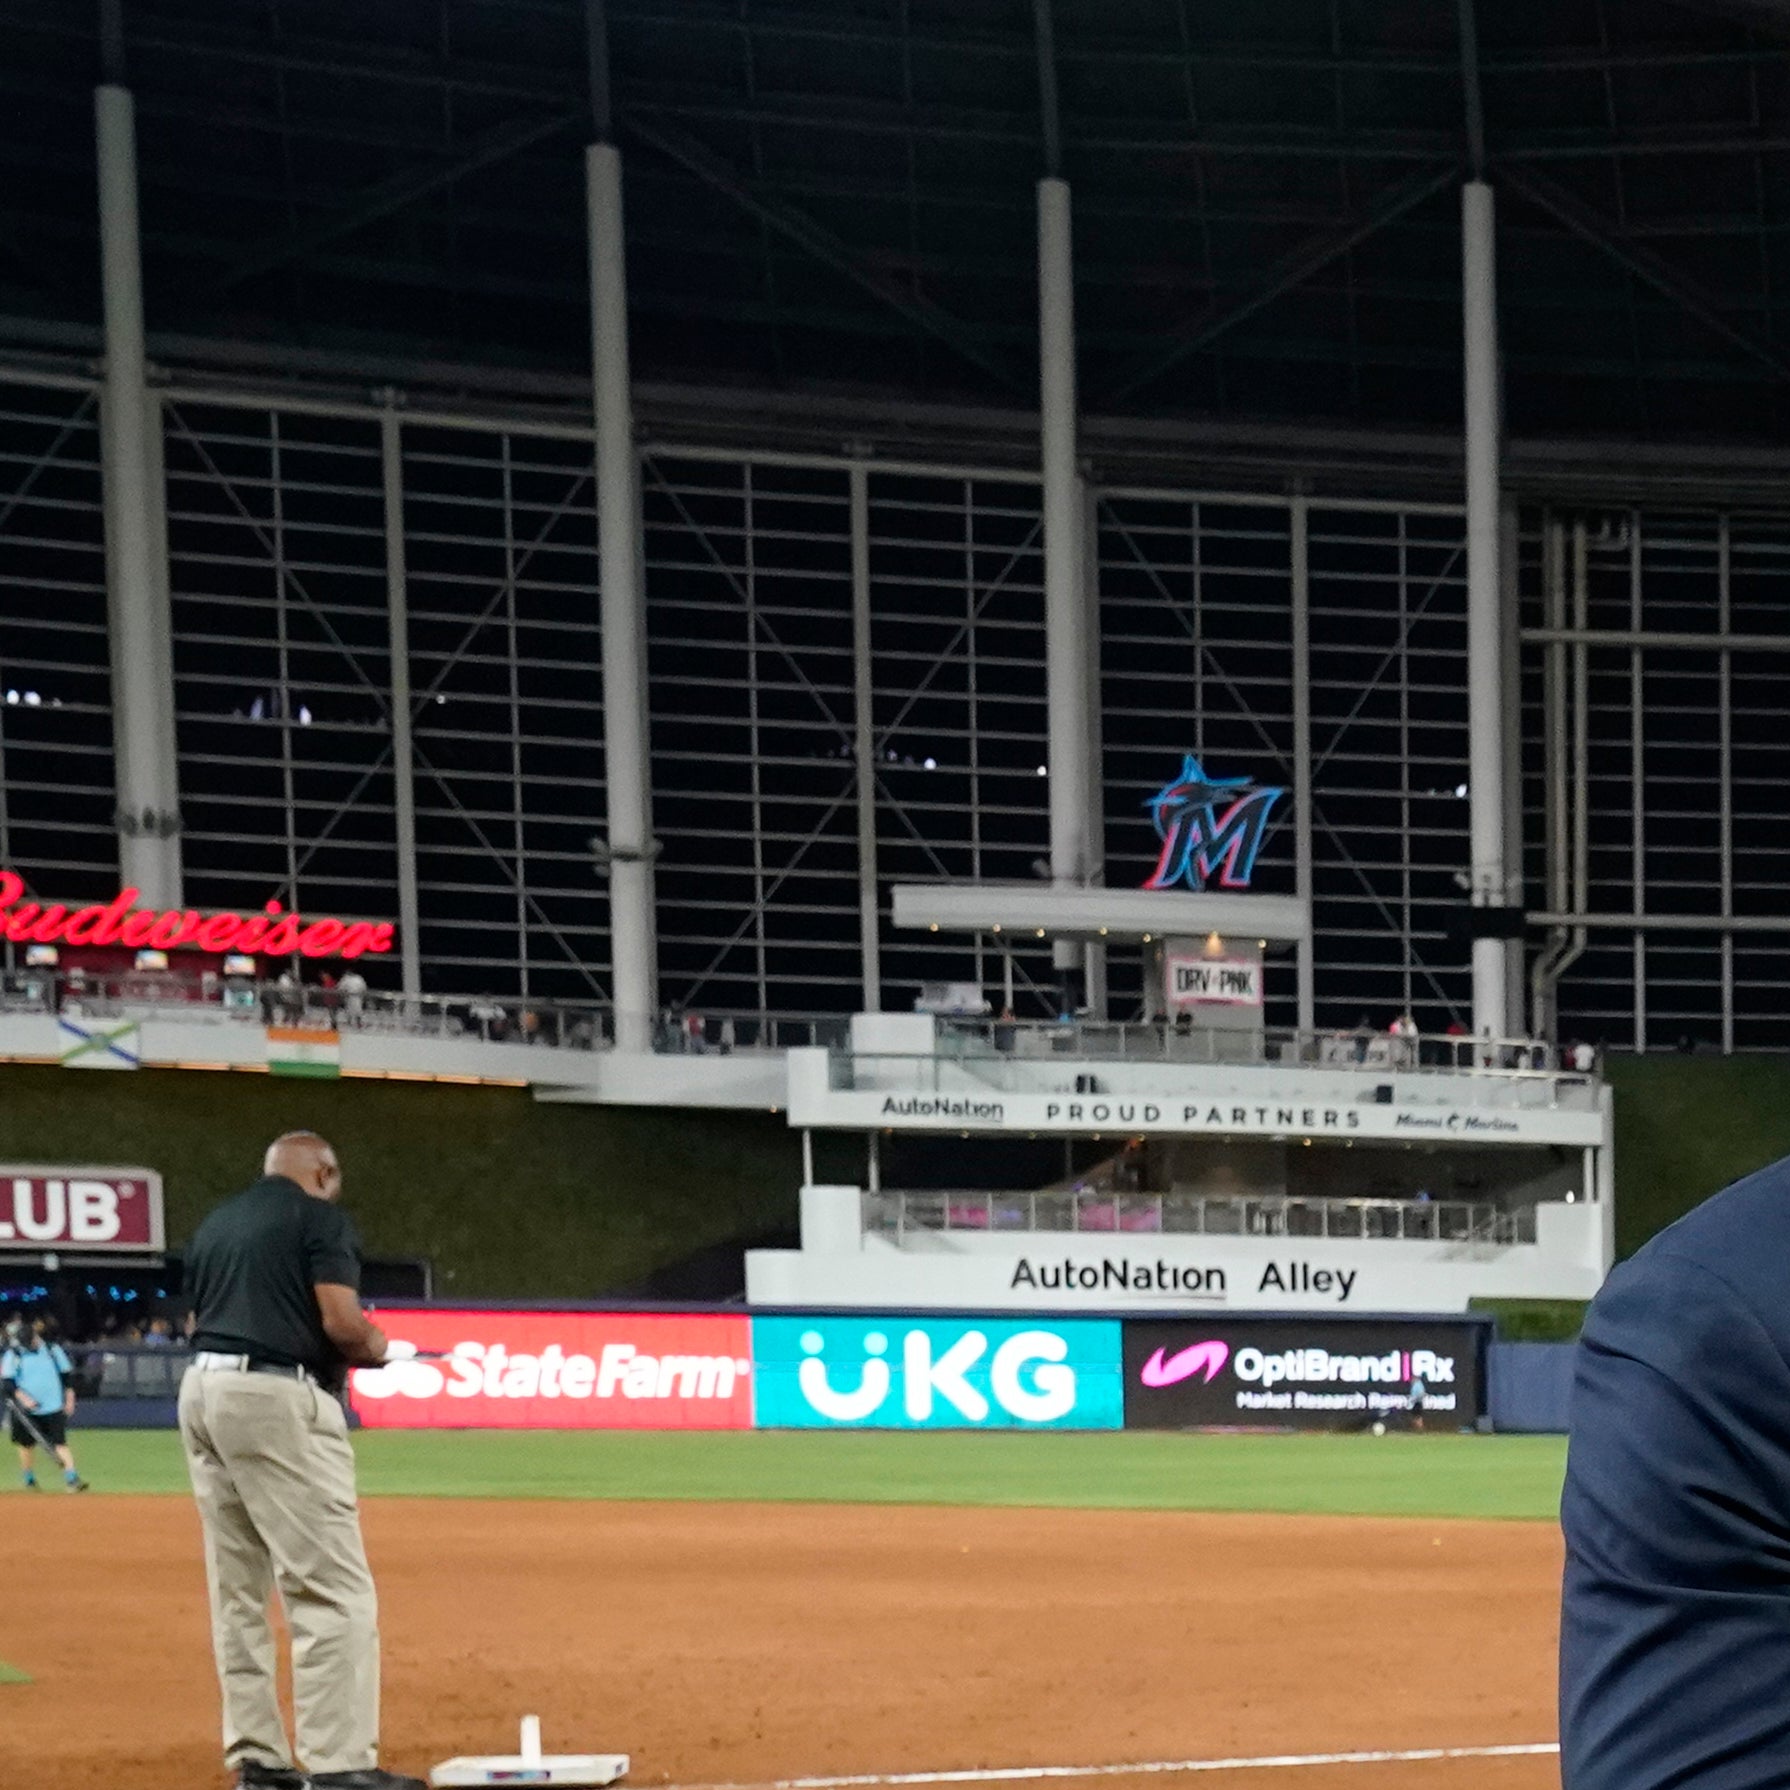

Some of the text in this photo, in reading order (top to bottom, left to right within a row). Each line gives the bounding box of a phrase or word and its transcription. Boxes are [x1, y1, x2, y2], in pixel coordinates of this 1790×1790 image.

[882, 1096, 1003, 1118] AutoNation
[1047, 1104, 1160, 1122] PROUD
[1184, 1106, 1360, 1129] PARTNERS
[1010, 1258, 1358, 1303] AutoNation Alley
